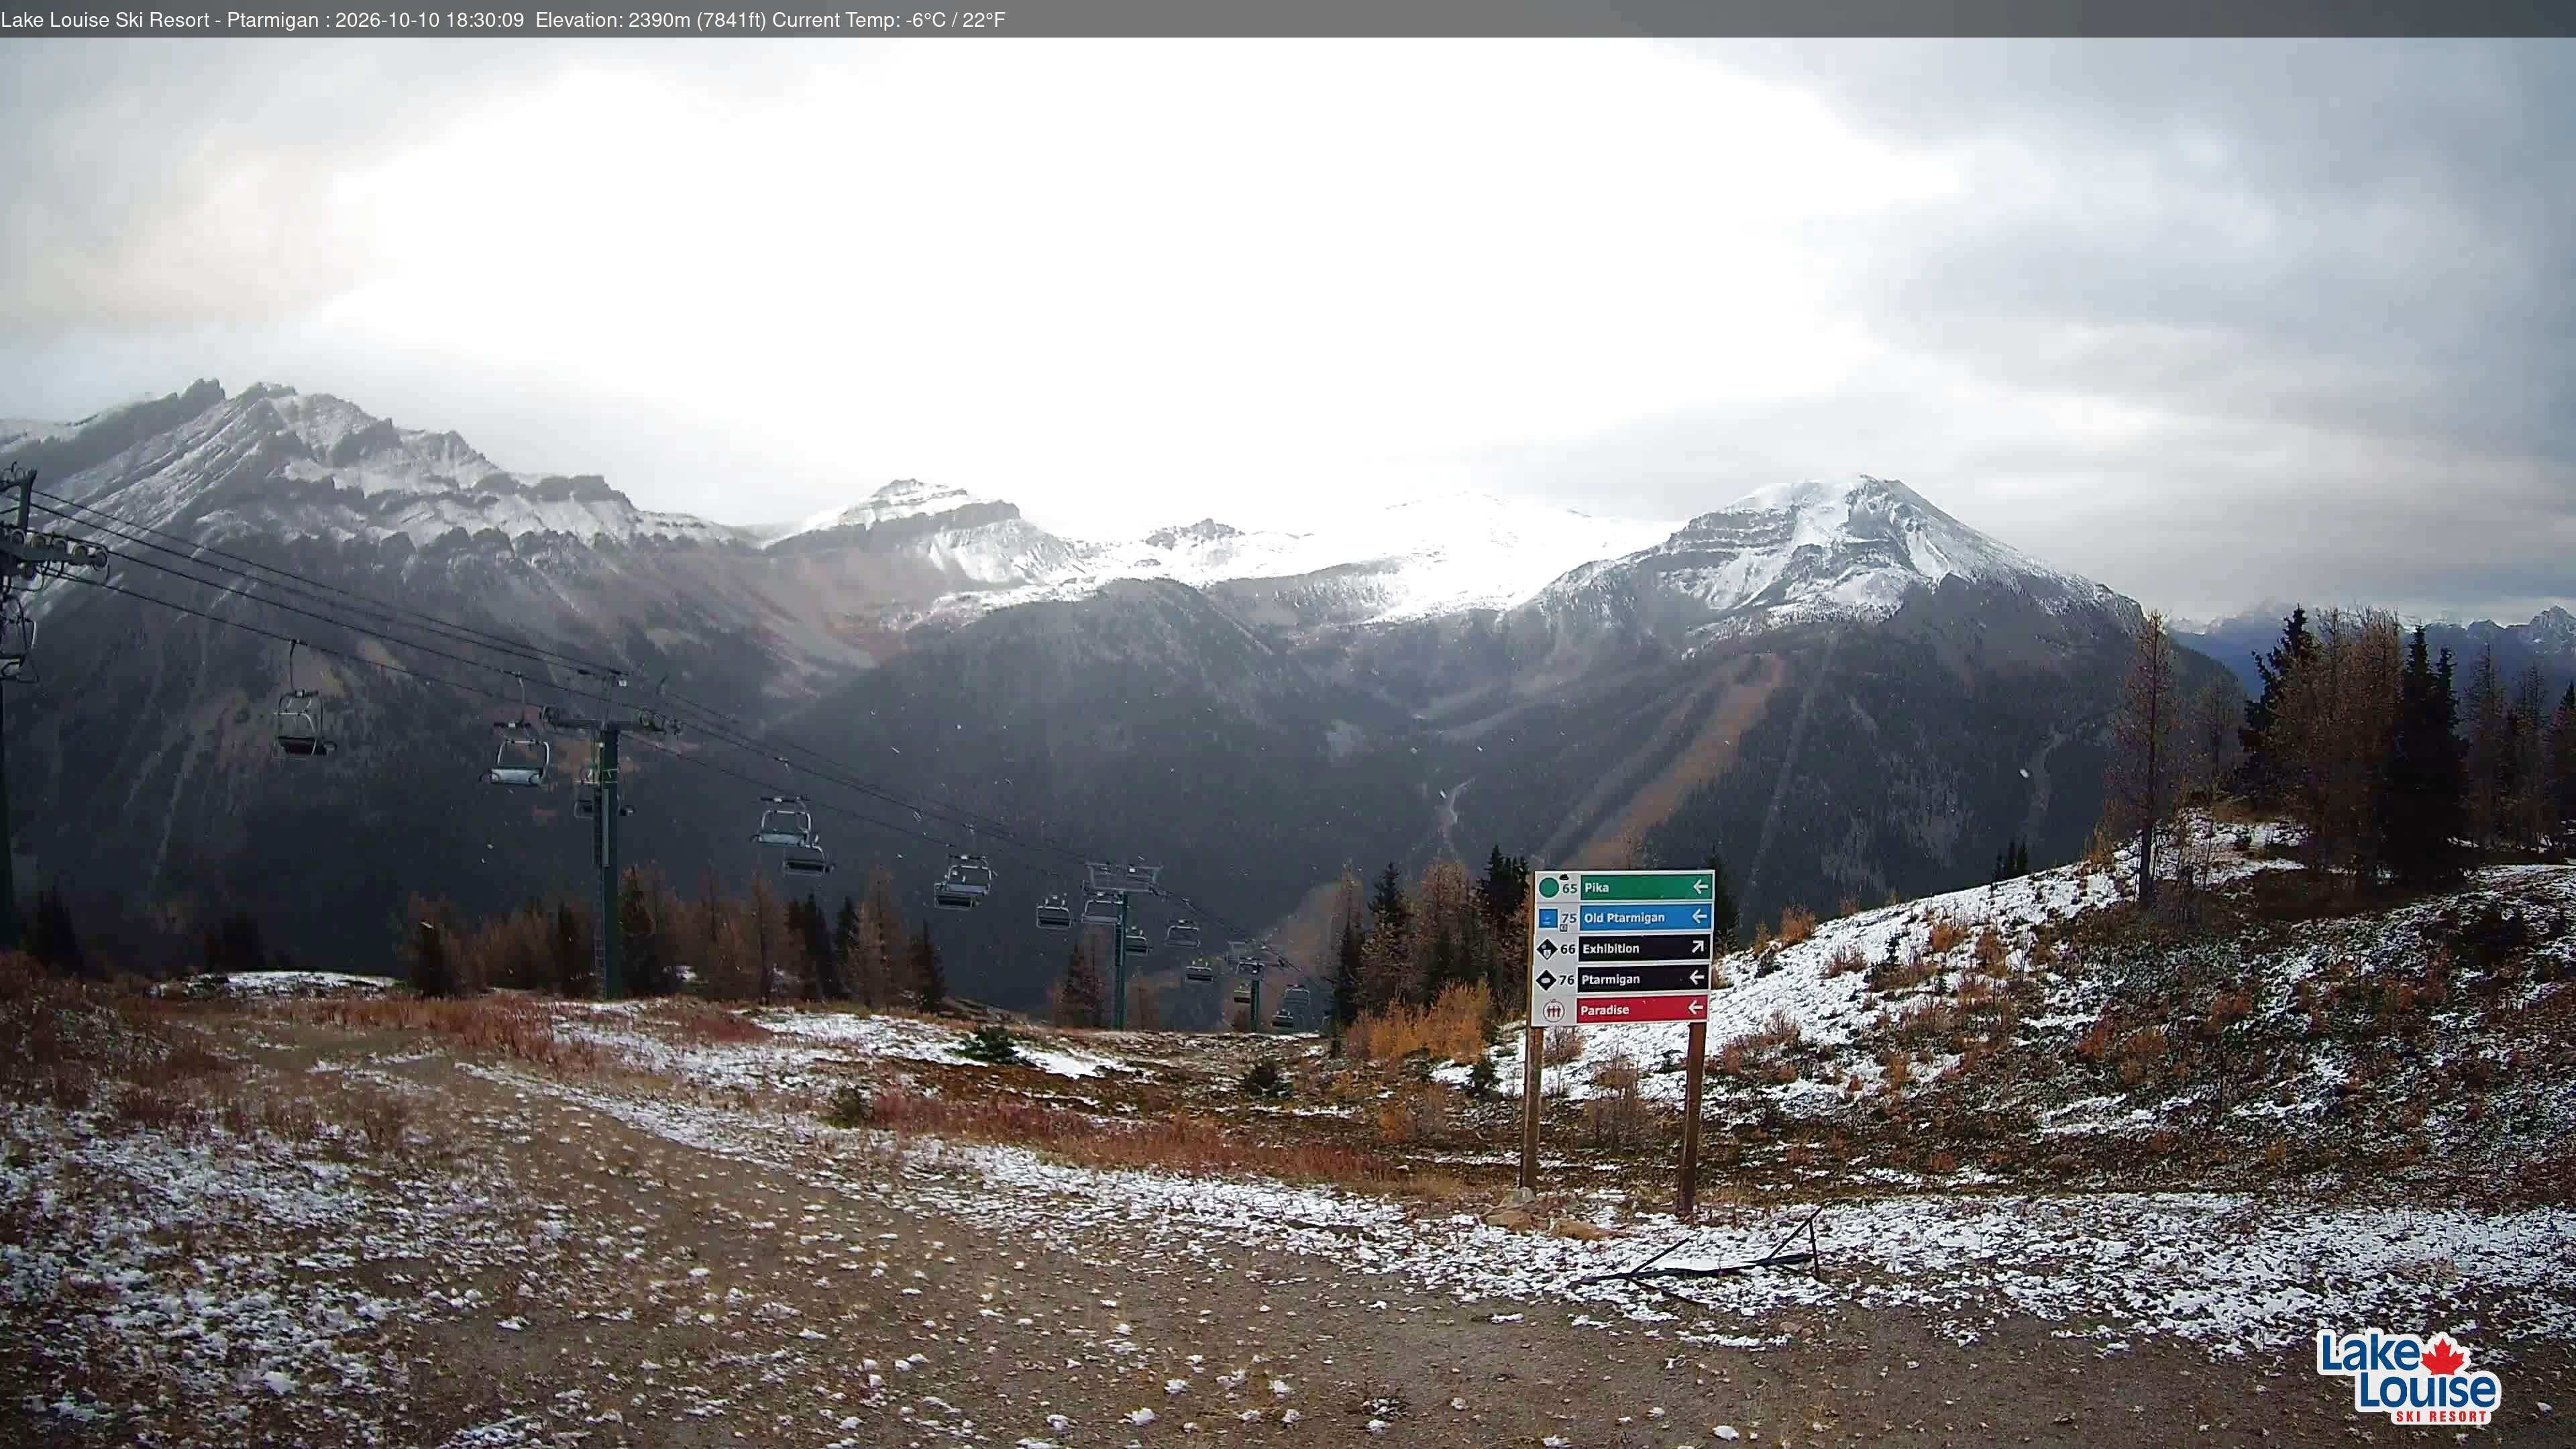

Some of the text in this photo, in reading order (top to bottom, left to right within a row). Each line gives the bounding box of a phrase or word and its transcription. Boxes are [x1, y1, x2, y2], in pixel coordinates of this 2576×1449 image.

[1562, 882, 1609, 894] 65 Pika
[1561, 912, 1665, 924] 75 Old Ptarmigan
[1560, 943, 1640, 955] 66 Exhibition
[1559, 974, 1640, 986] 76 Ptarmigan
[1580, 1005, 1629, 1016] Paradise
